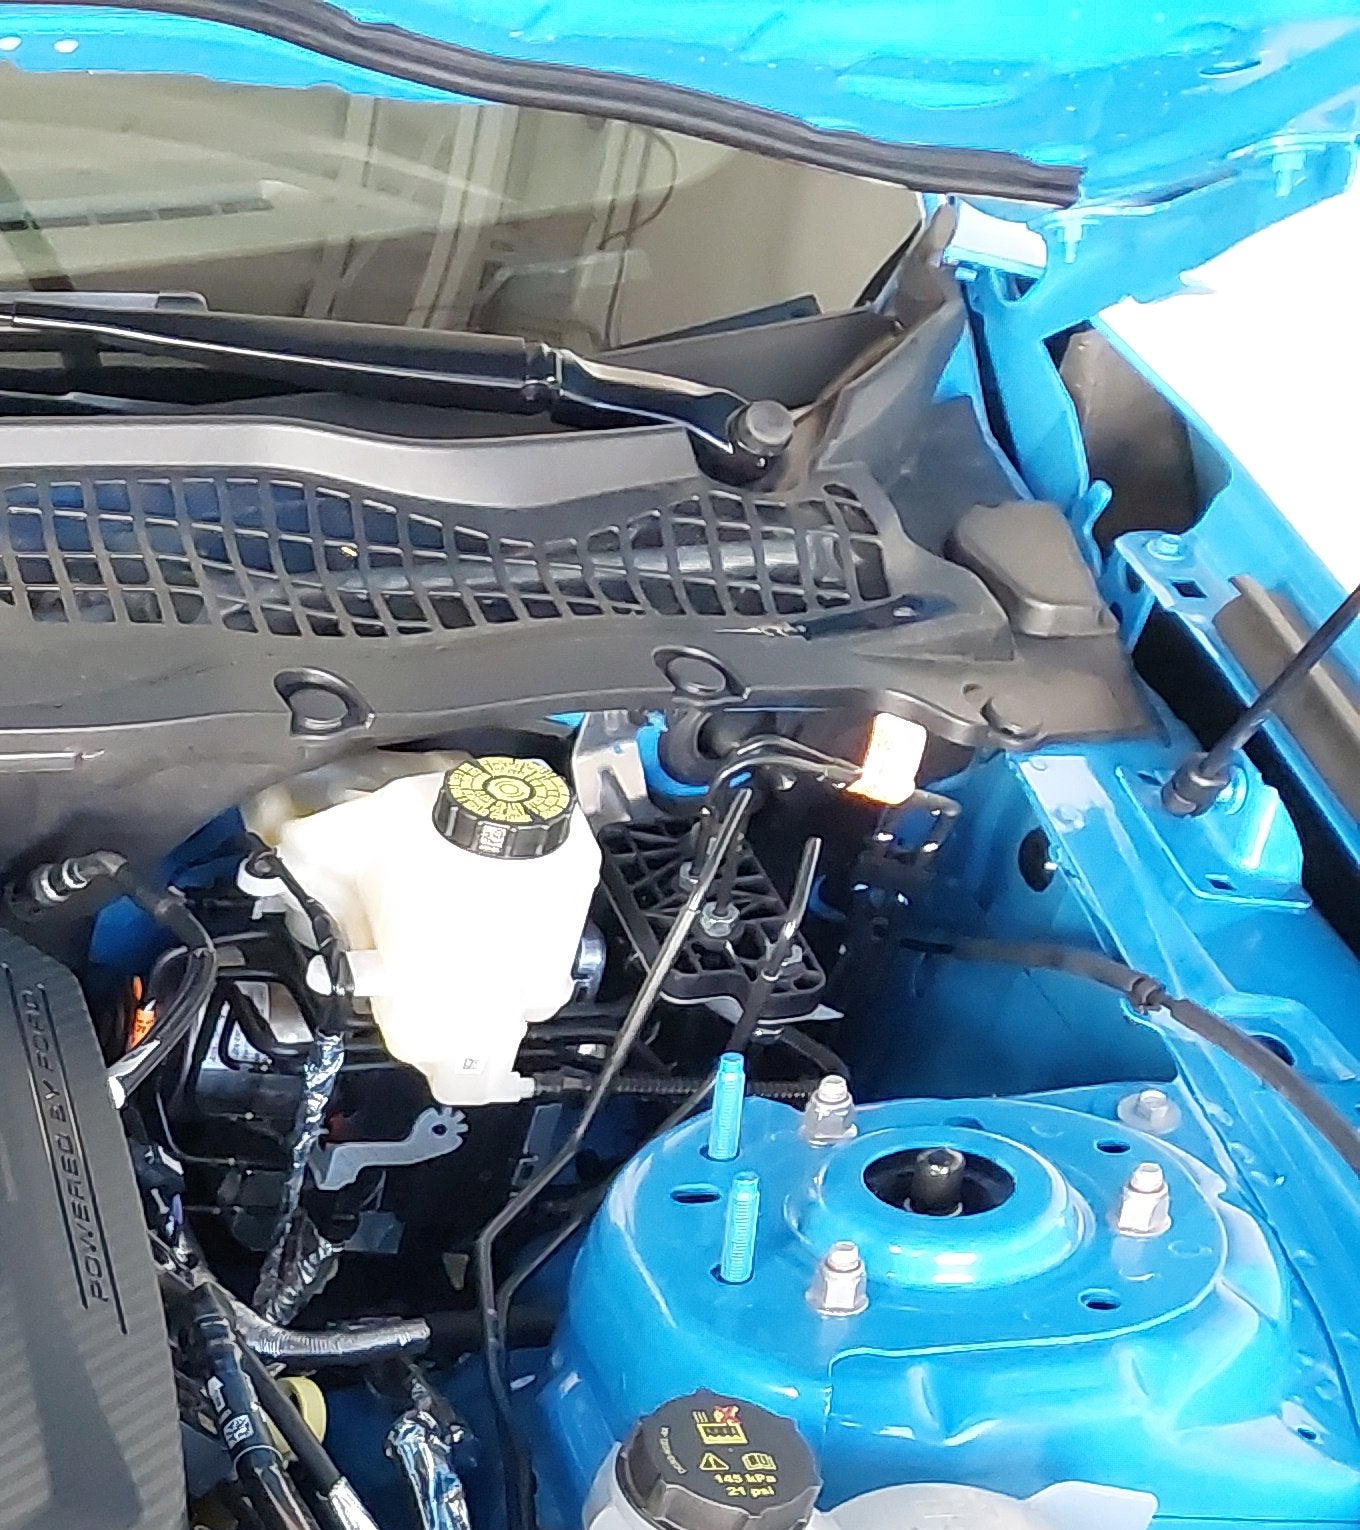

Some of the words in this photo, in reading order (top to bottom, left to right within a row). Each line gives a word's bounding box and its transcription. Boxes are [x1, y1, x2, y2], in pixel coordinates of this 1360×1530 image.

[19, 986, 55, 1074] FORD
[42, 1078, 68, 1125] BY
[52, 1131, 110, 1303] POWERED
[725, 1485, 747, 1497] 21
[749, 1484, 776, 1499] psi
[744, 1472, 778, 1484] kPa
